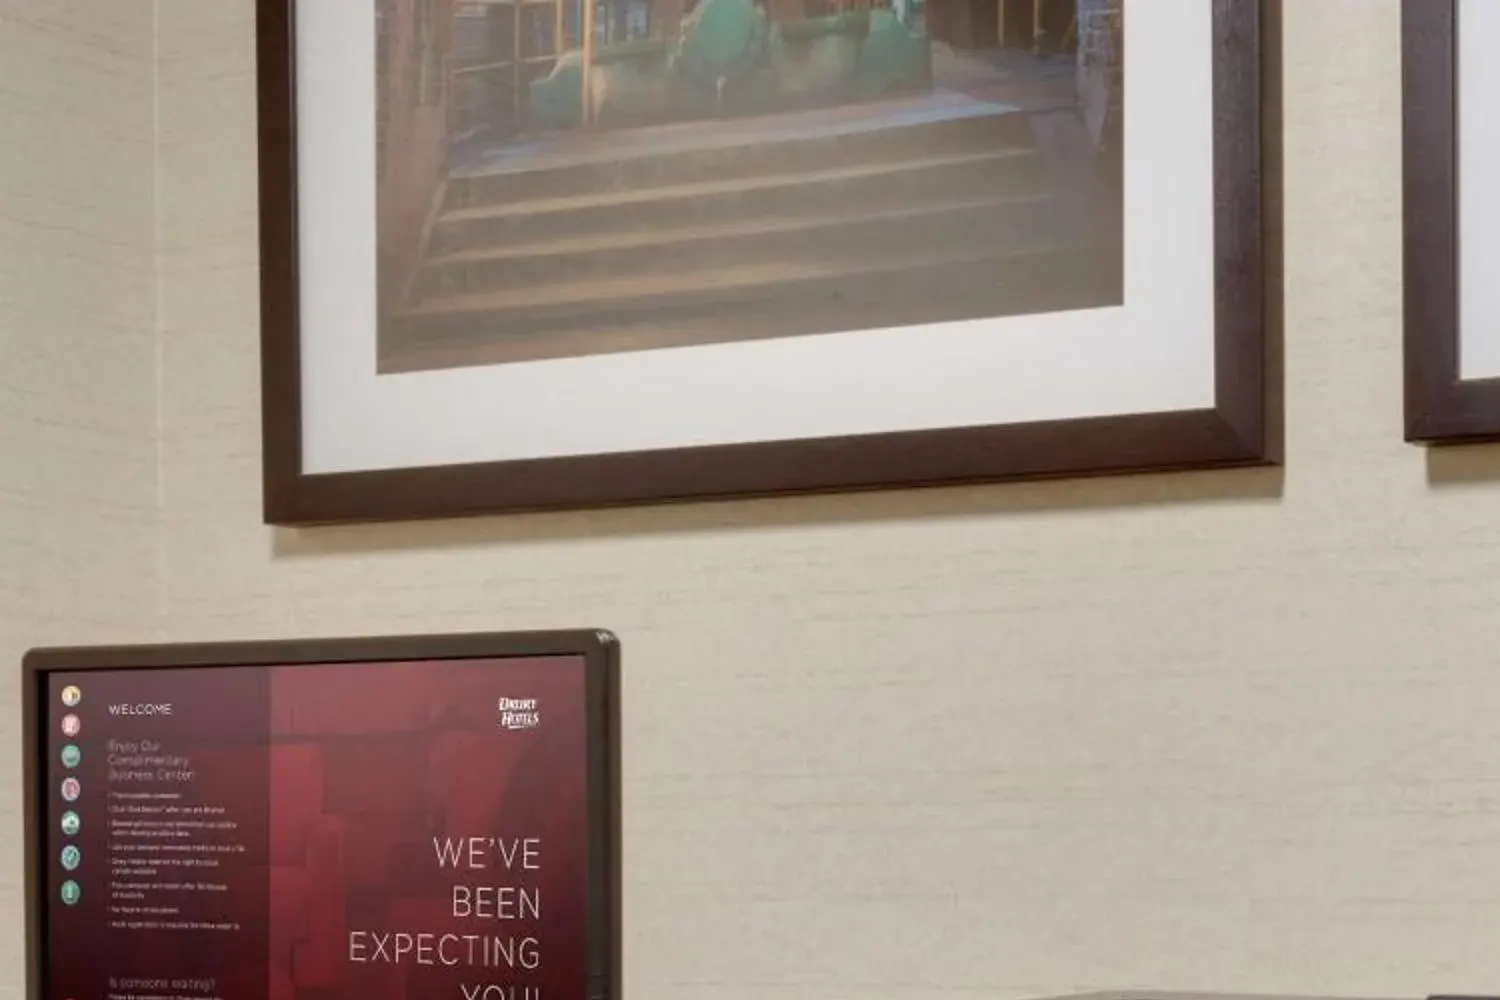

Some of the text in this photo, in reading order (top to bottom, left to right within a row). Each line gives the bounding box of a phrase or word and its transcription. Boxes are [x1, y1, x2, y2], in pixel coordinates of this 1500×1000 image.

[108, 703, 173, 715] WELCOME
[433, 837, 540, 869] WE'VE
[453, 886, 539, 920] BEEN
[349, 931, 540, 969] EXPECTING
